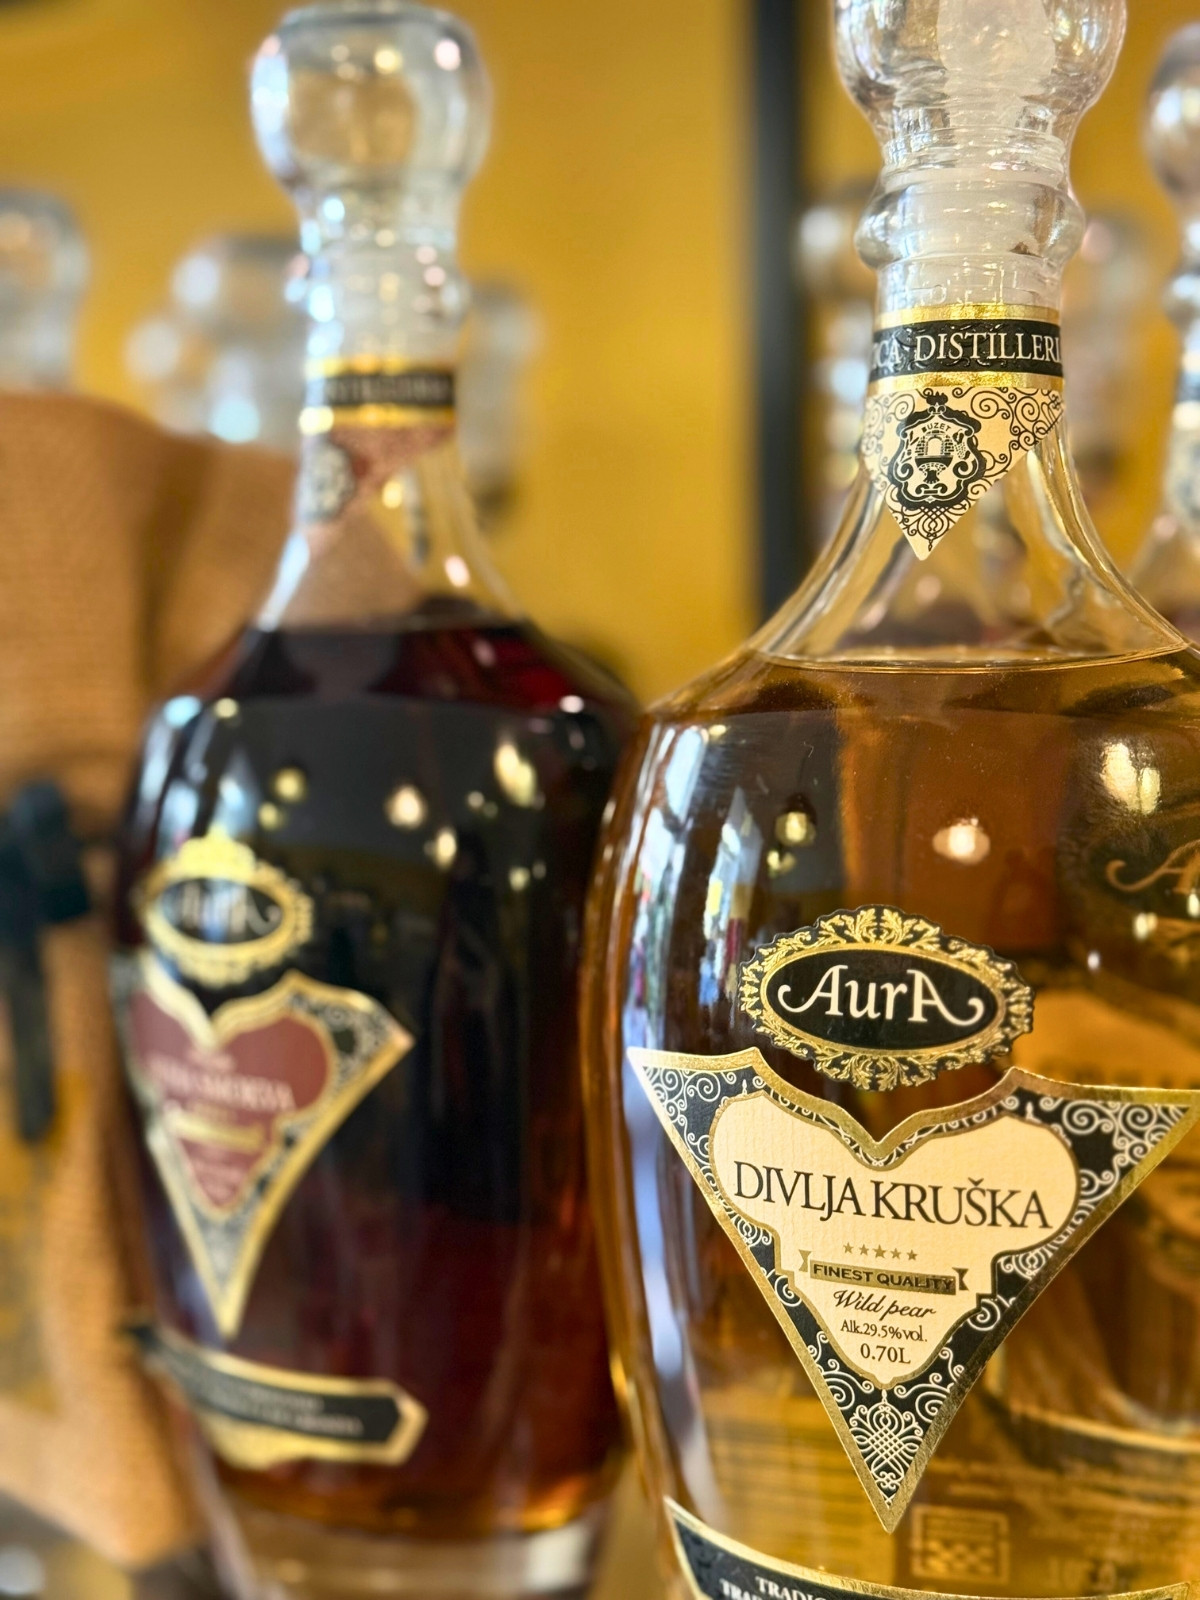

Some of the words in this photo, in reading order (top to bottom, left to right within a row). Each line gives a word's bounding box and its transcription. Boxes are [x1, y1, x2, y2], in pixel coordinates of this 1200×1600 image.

[778, 964, 984, 1027] AurA
[733, 1160, 866, 1222] DIVLJA
[871, 1176, 1053, 1229] KRUŠKA
[813, 1264, 873, 1282] FINEST
[876, 1273, 954, 1290] QUALITY
[833, 1289, 887, 1313] Wild
[879, 1300, 936, 1322] pear
[860, 1343, 911, 1365] 0.70L
